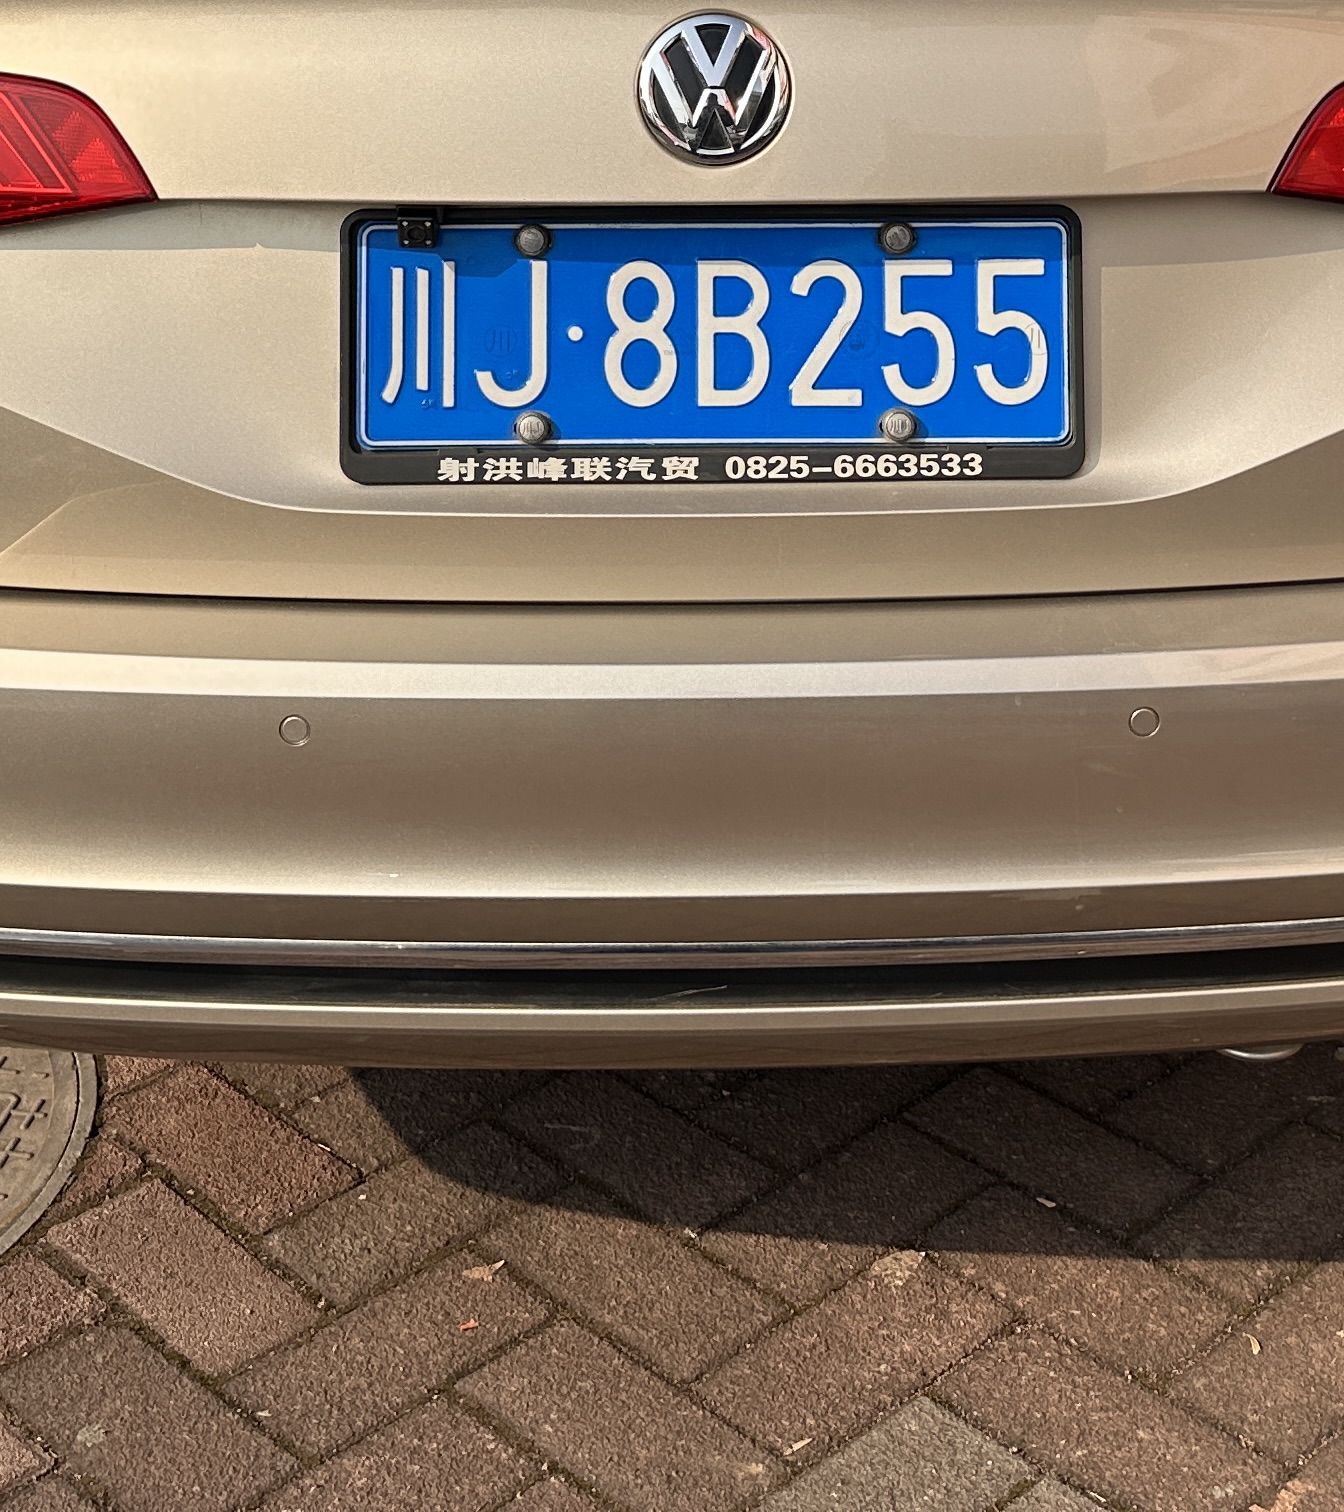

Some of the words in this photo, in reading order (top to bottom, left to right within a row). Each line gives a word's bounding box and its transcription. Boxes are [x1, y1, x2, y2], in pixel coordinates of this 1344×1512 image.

[380, 258, 1051, 408] 川J·8B255
[437, 455, 701, 483] 射洪峰联汽贸
[725, 452, 985, 480] 0825-6663533
